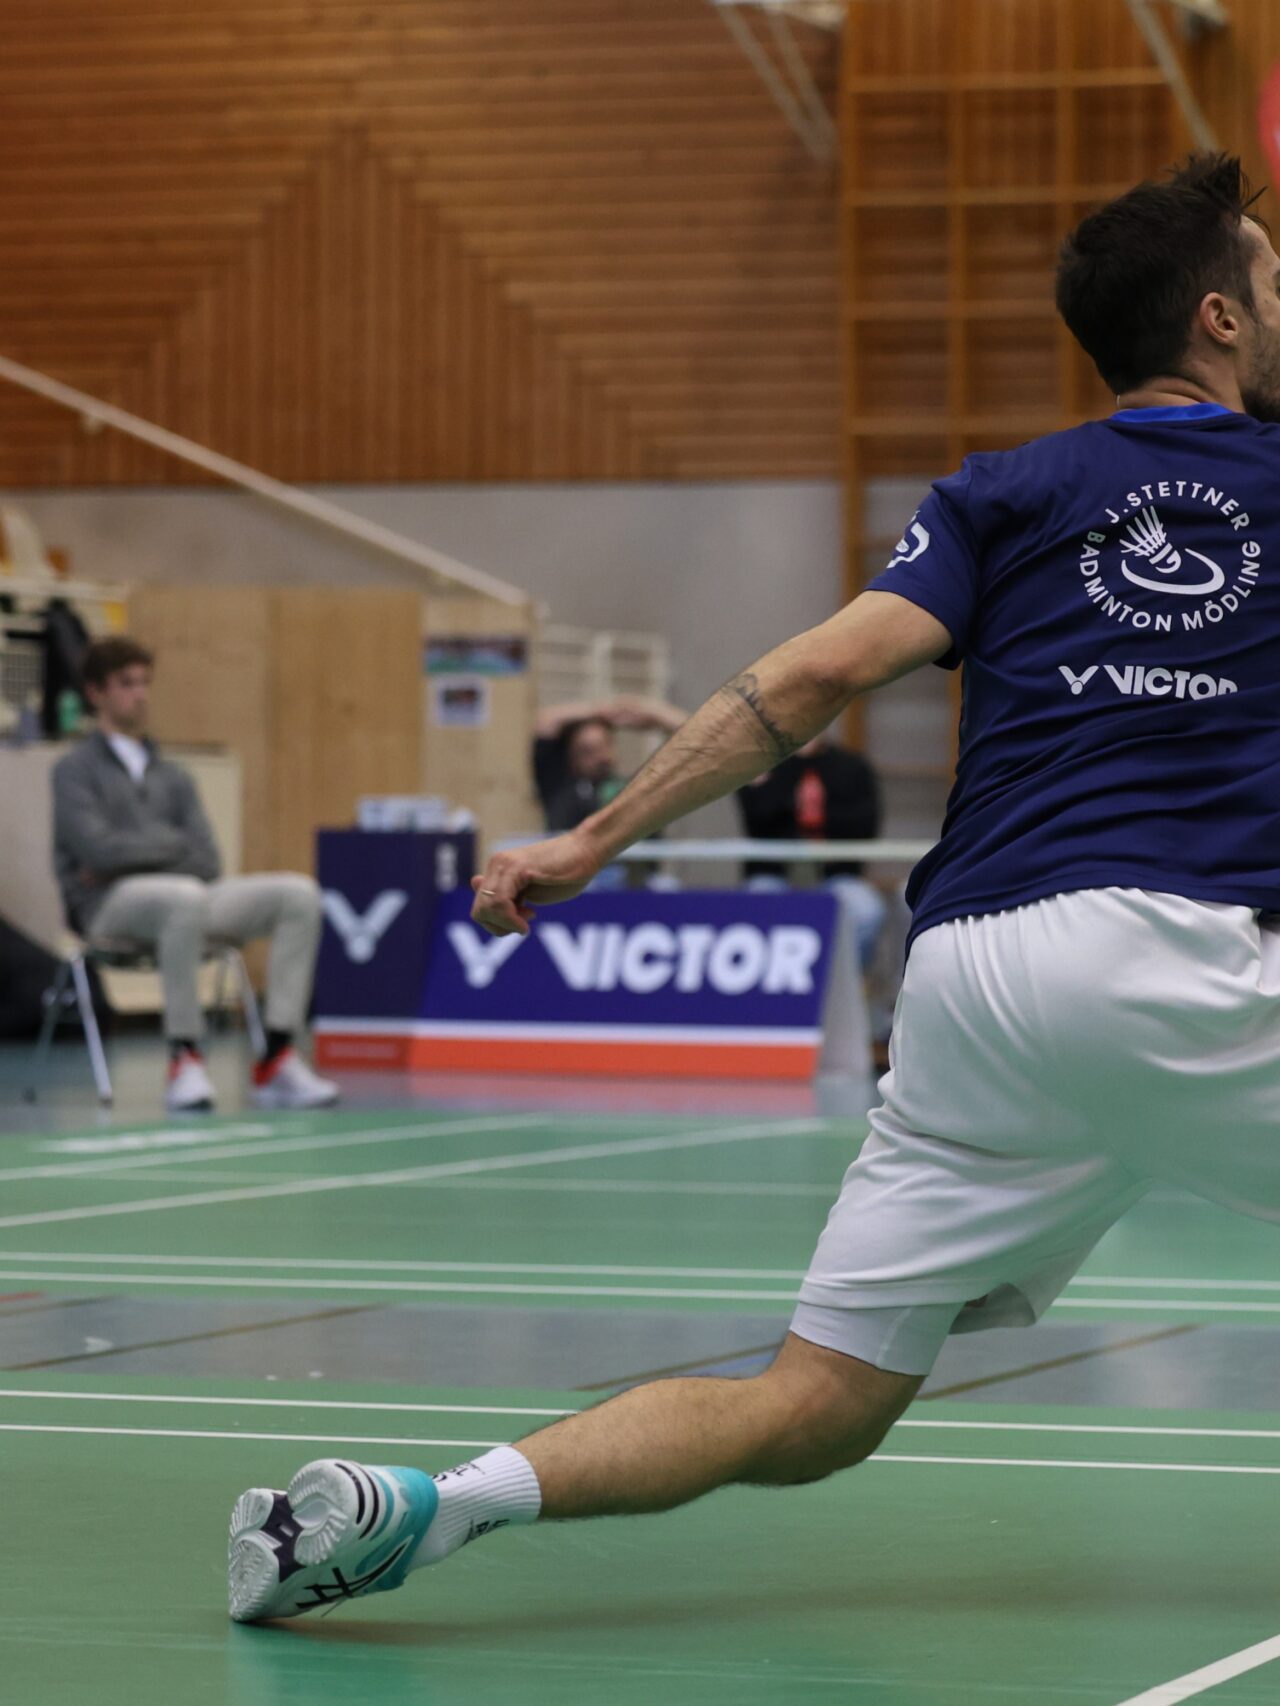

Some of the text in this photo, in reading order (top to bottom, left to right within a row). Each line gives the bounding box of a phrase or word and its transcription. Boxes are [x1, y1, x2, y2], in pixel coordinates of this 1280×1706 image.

[1079, 531, 1261, 632] BADMINTON MÖDLING
[540, 922, 822, 995] VICTOR
